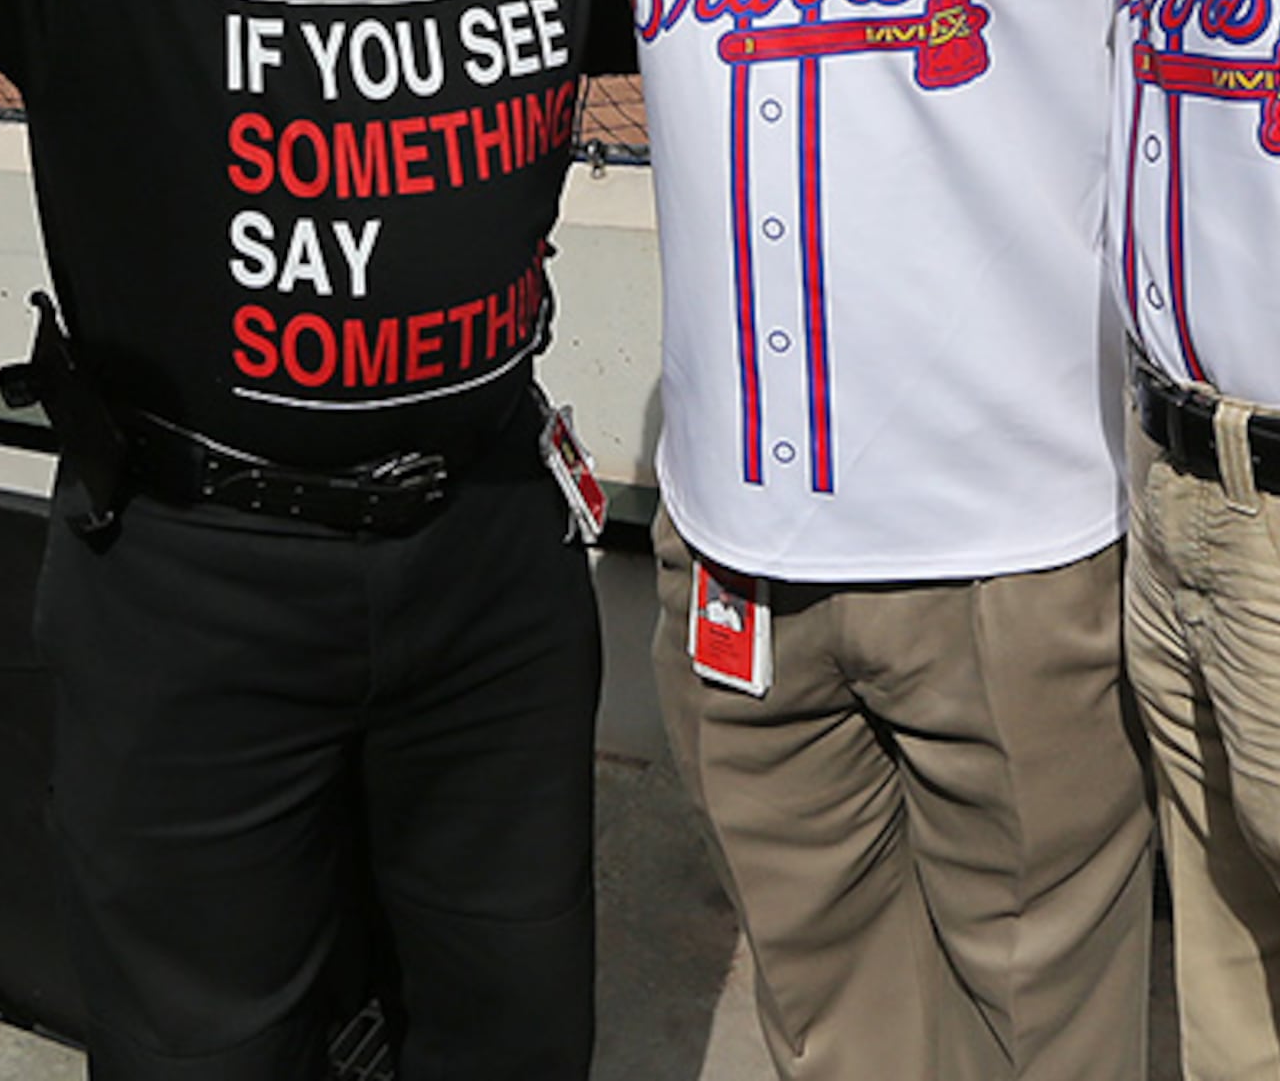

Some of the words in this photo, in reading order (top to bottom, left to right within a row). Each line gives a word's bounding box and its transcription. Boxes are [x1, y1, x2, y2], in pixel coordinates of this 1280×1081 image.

[226, 14, 285, 94] IF
[300, 17, 445, 101] YOU
[227, 79, 575, 200] SOMETHING
[228, 210, 382, 298] SAY
[231, 239, 547, 389] SOMETHIN
